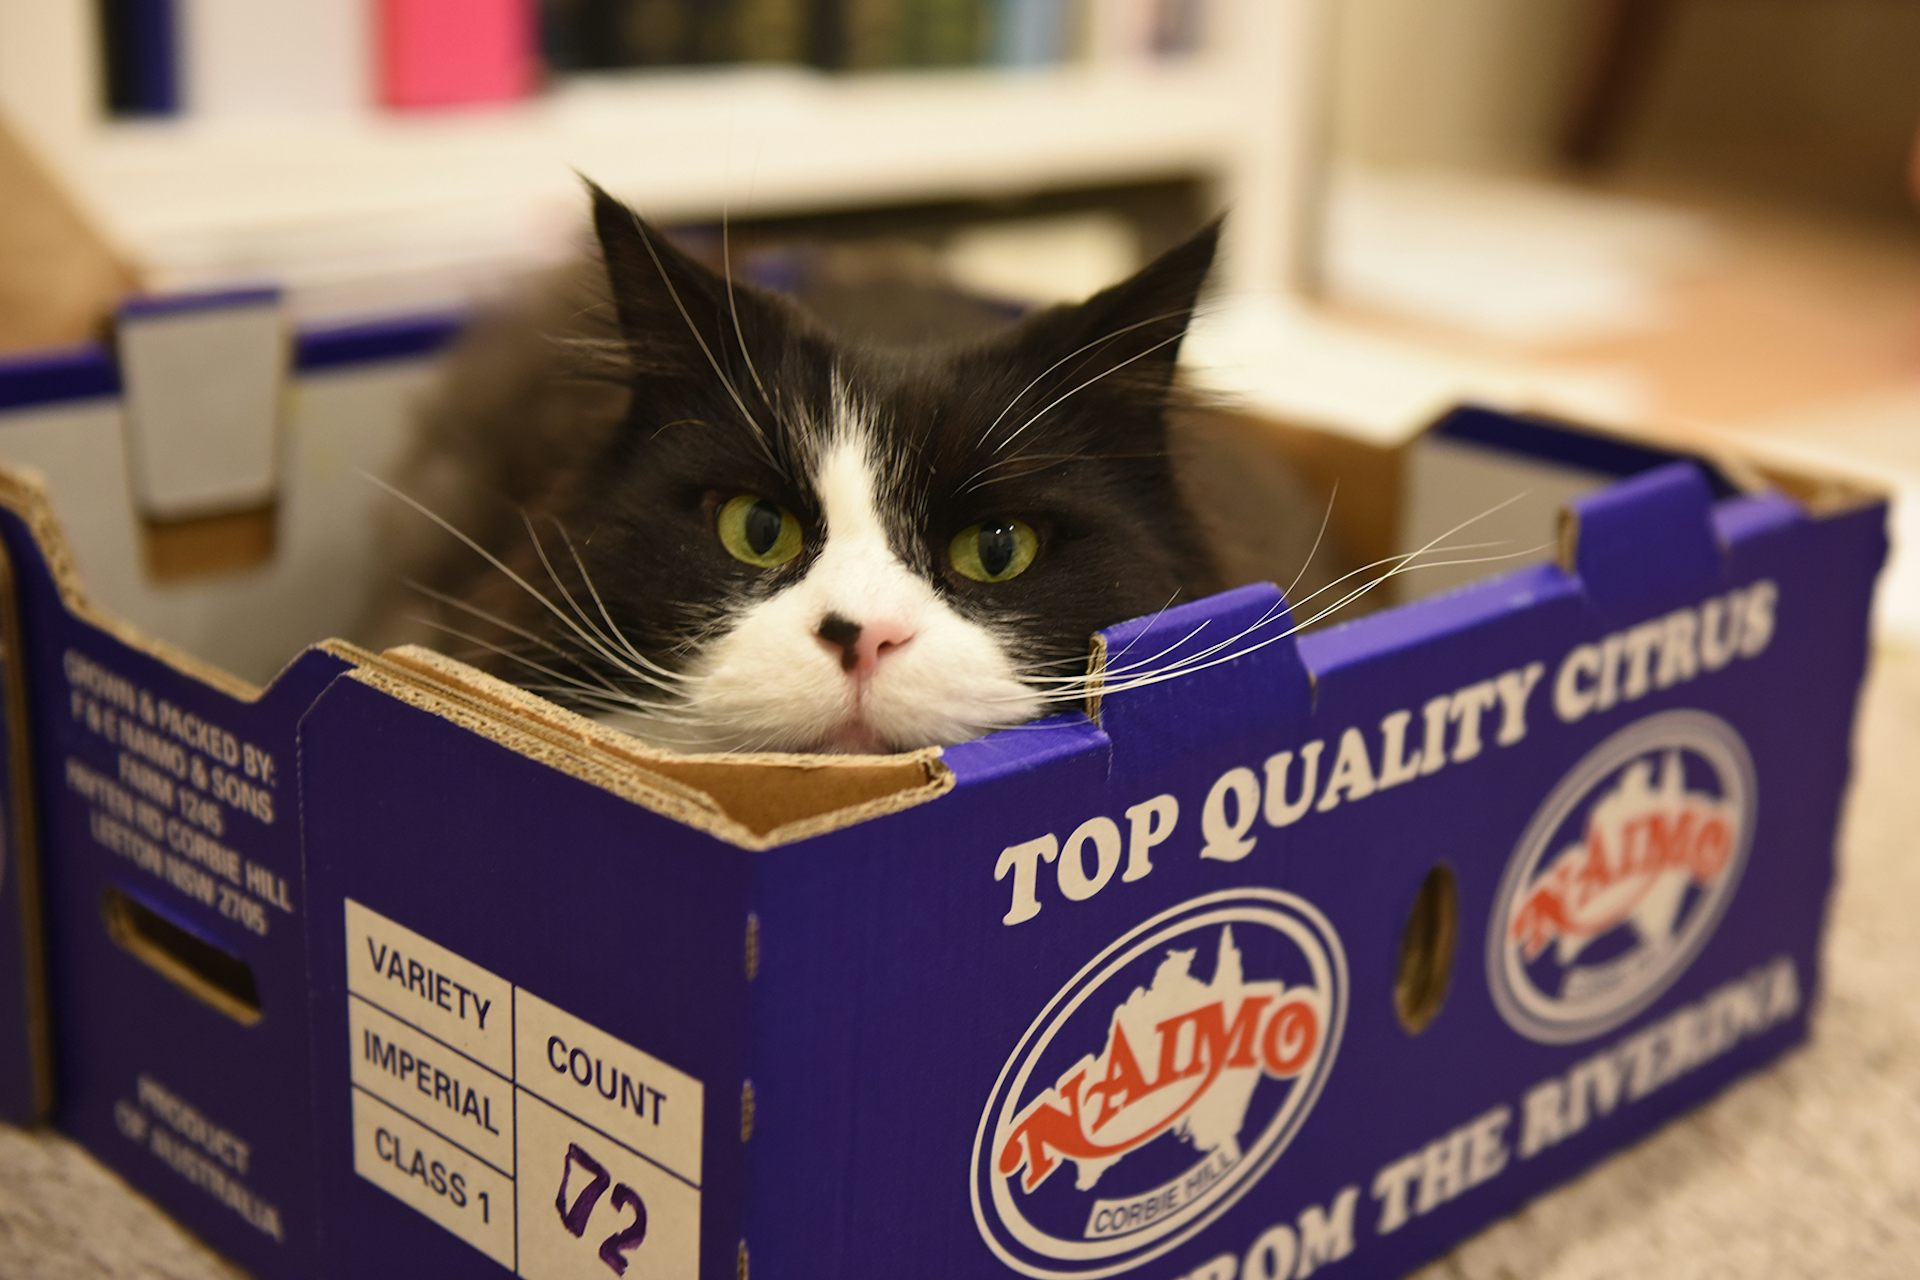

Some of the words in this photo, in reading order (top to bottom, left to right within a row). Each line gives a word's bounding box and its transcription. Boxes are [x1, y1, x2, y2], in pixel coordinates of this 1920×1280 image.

[63, 648, 136, 714] GROWN
[158, 700, 240, 767] PACKED
[243, 743, 276, 787] BY:
[995, 795, 1179, 927] TOP
[1200, 662, 1544, 863] QUALITY
[1554, 581, 1779, 722] CITRUS
[119, 716, 187, 779] NAIMO
[191, 756, 207, 790] &
[212, 766, 275, 824] SONS
[119, 751, 173, 808] FARM
[166, 852, 215, 906] NSW
[218, 884, 268, 936] 2705
[167, 818, 241, 885] CORBIE
[246, 859, 293, 913] HILL
[1512, 808, 1735, 965] NAIMO
[367, 937, 491, 1030] VARIETY
[137, 1074, 249, 1175] PRODUCT
[364, 1028, 499, 1136] IMPERIAL
[547, 1035, 667, 1126] COUNT
[999, 996, 1318, 1190] NAIMO
[1371, 1106, 1511, 1235] THE
[1517, 955, 1800, 1159] RIVERINA
[151, 1126, 284, 1243] AUSTRALIA
[375, 1126, 467, 1208] CLASS
[478, 1191, 490, 1224] 1
[1094, 1185, 1179, 1234] CORBIE
[1185, 1153, 1235, 1200] HILL
